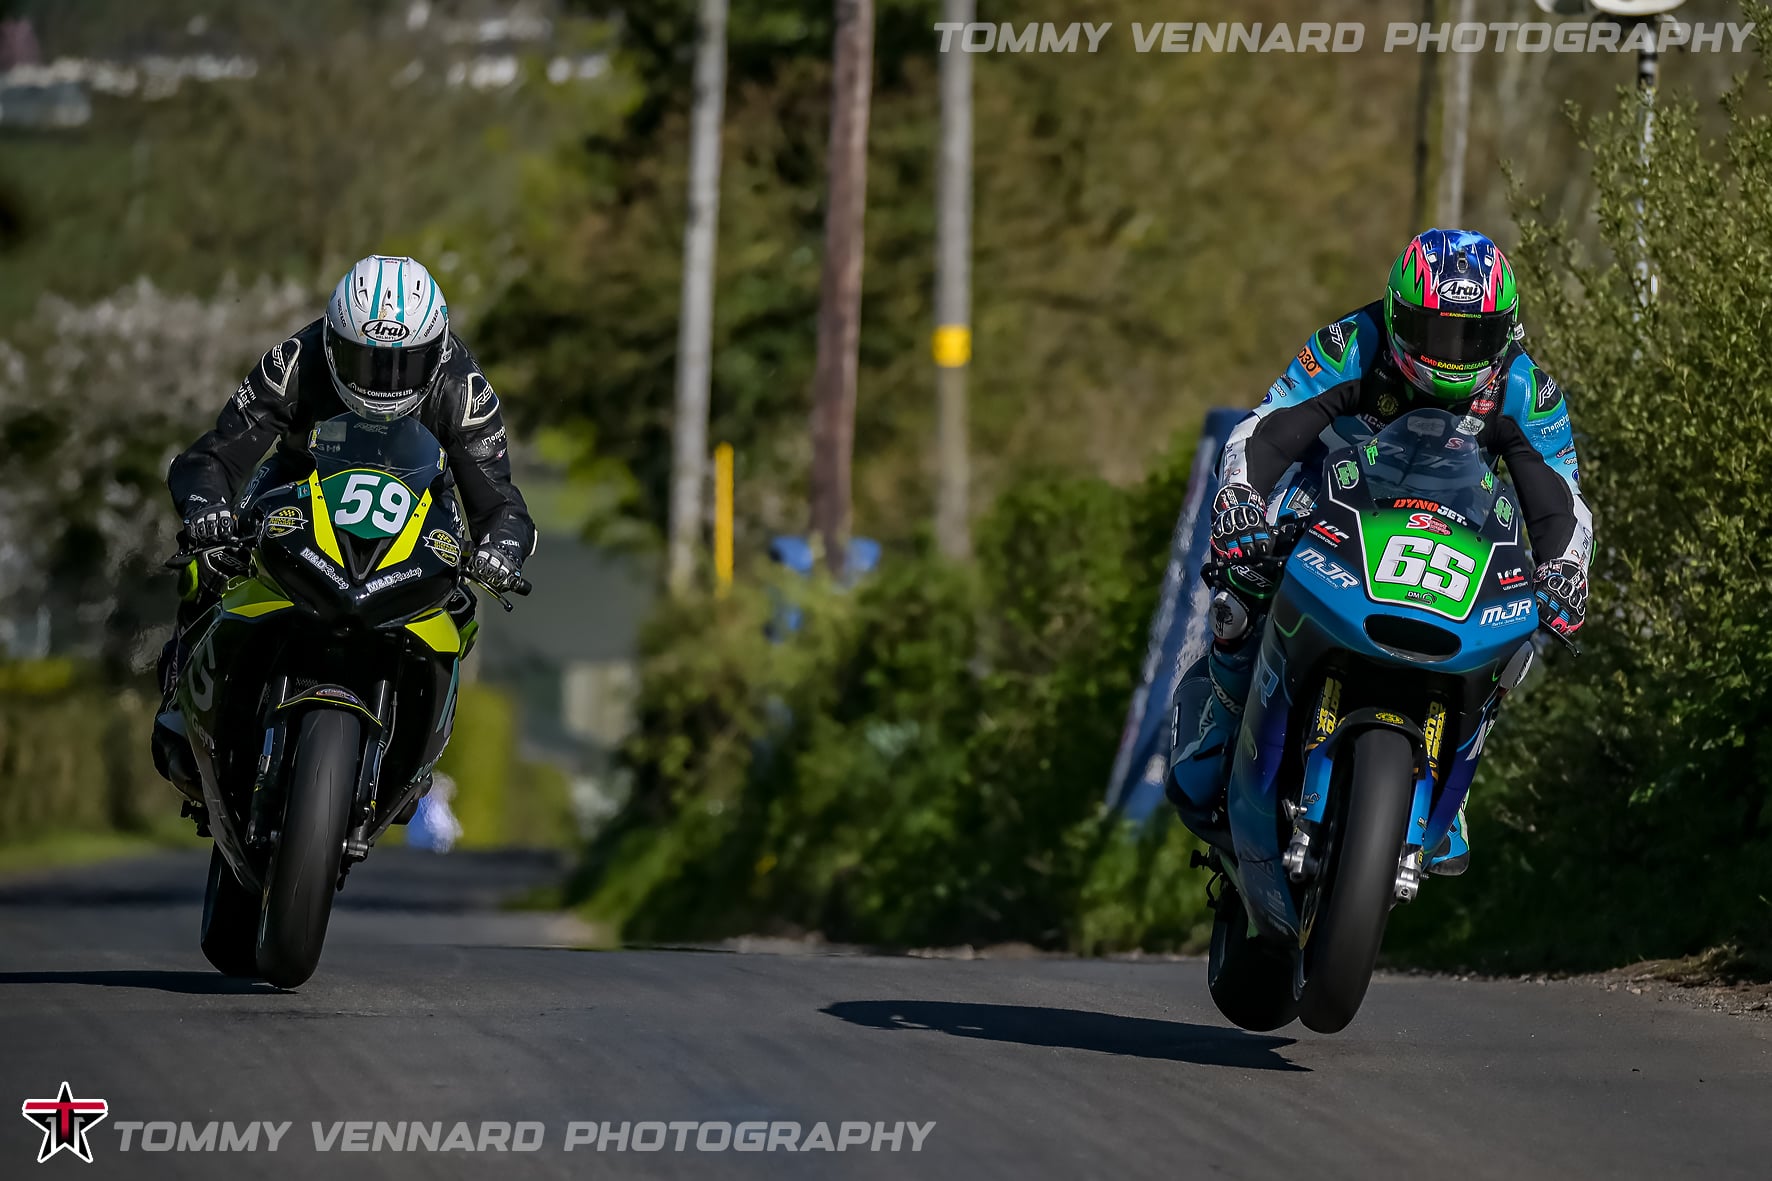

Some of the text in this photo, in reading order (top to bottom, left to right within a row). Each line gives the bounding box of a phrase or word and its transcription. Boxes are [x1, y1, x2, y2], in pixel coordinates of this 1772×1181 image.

[1440, 282, 1479, 297] Arai
[365, 322, 406, 337] Arai
[1437, 360, 1464, 371] RACING
[1464, 360, 1490, 370] IRELAND
[367, 390, 402, 398] CONTRACTS
[334, 474, 411, 534] 59
[1295, 548, 1359, 589] MJR
[1374, 535, 1476, 601] 65
[1481, 599, 1531, 625] MJR
